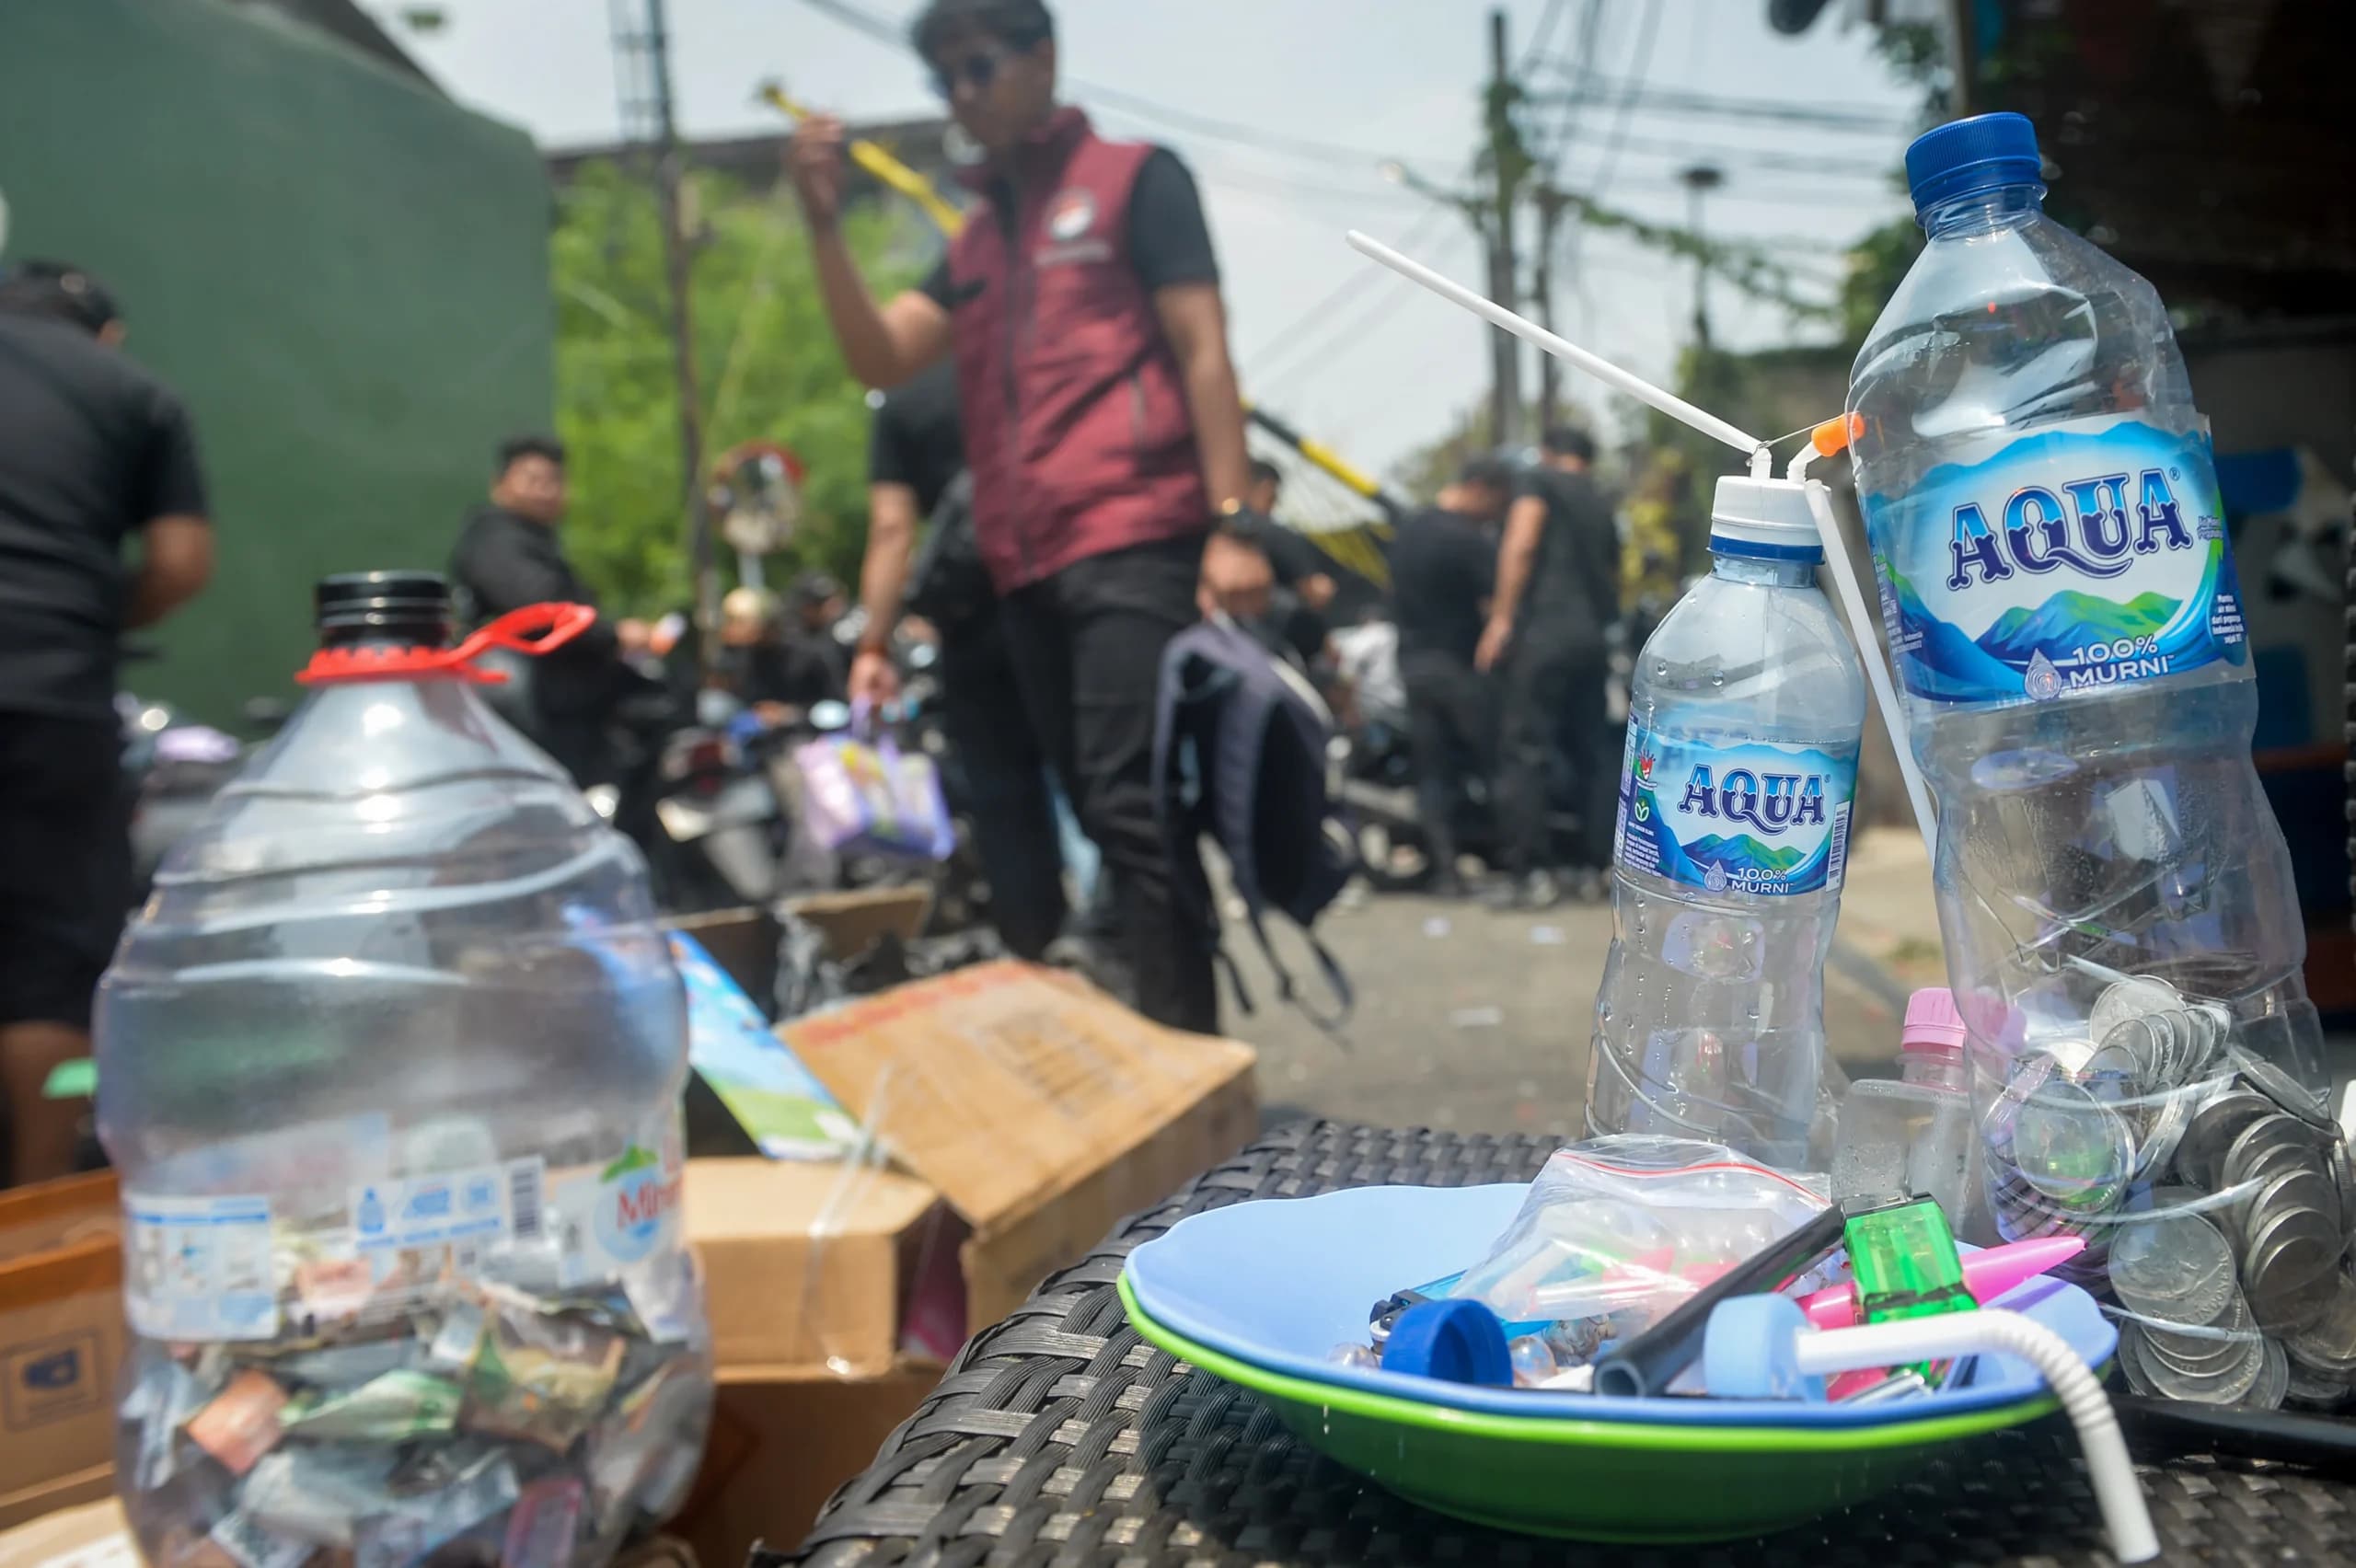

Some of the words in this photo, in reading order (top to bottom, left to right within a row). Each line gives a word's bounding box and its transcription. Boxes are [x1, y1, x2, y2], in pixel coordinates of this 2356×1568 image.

[1946, 467, 2194, 591] AQUA
[2072, 633, 2158, 665] 100%
[1677, 764, 1827, 836] AQUA
[1738, 867, 1787, 881] 100%
